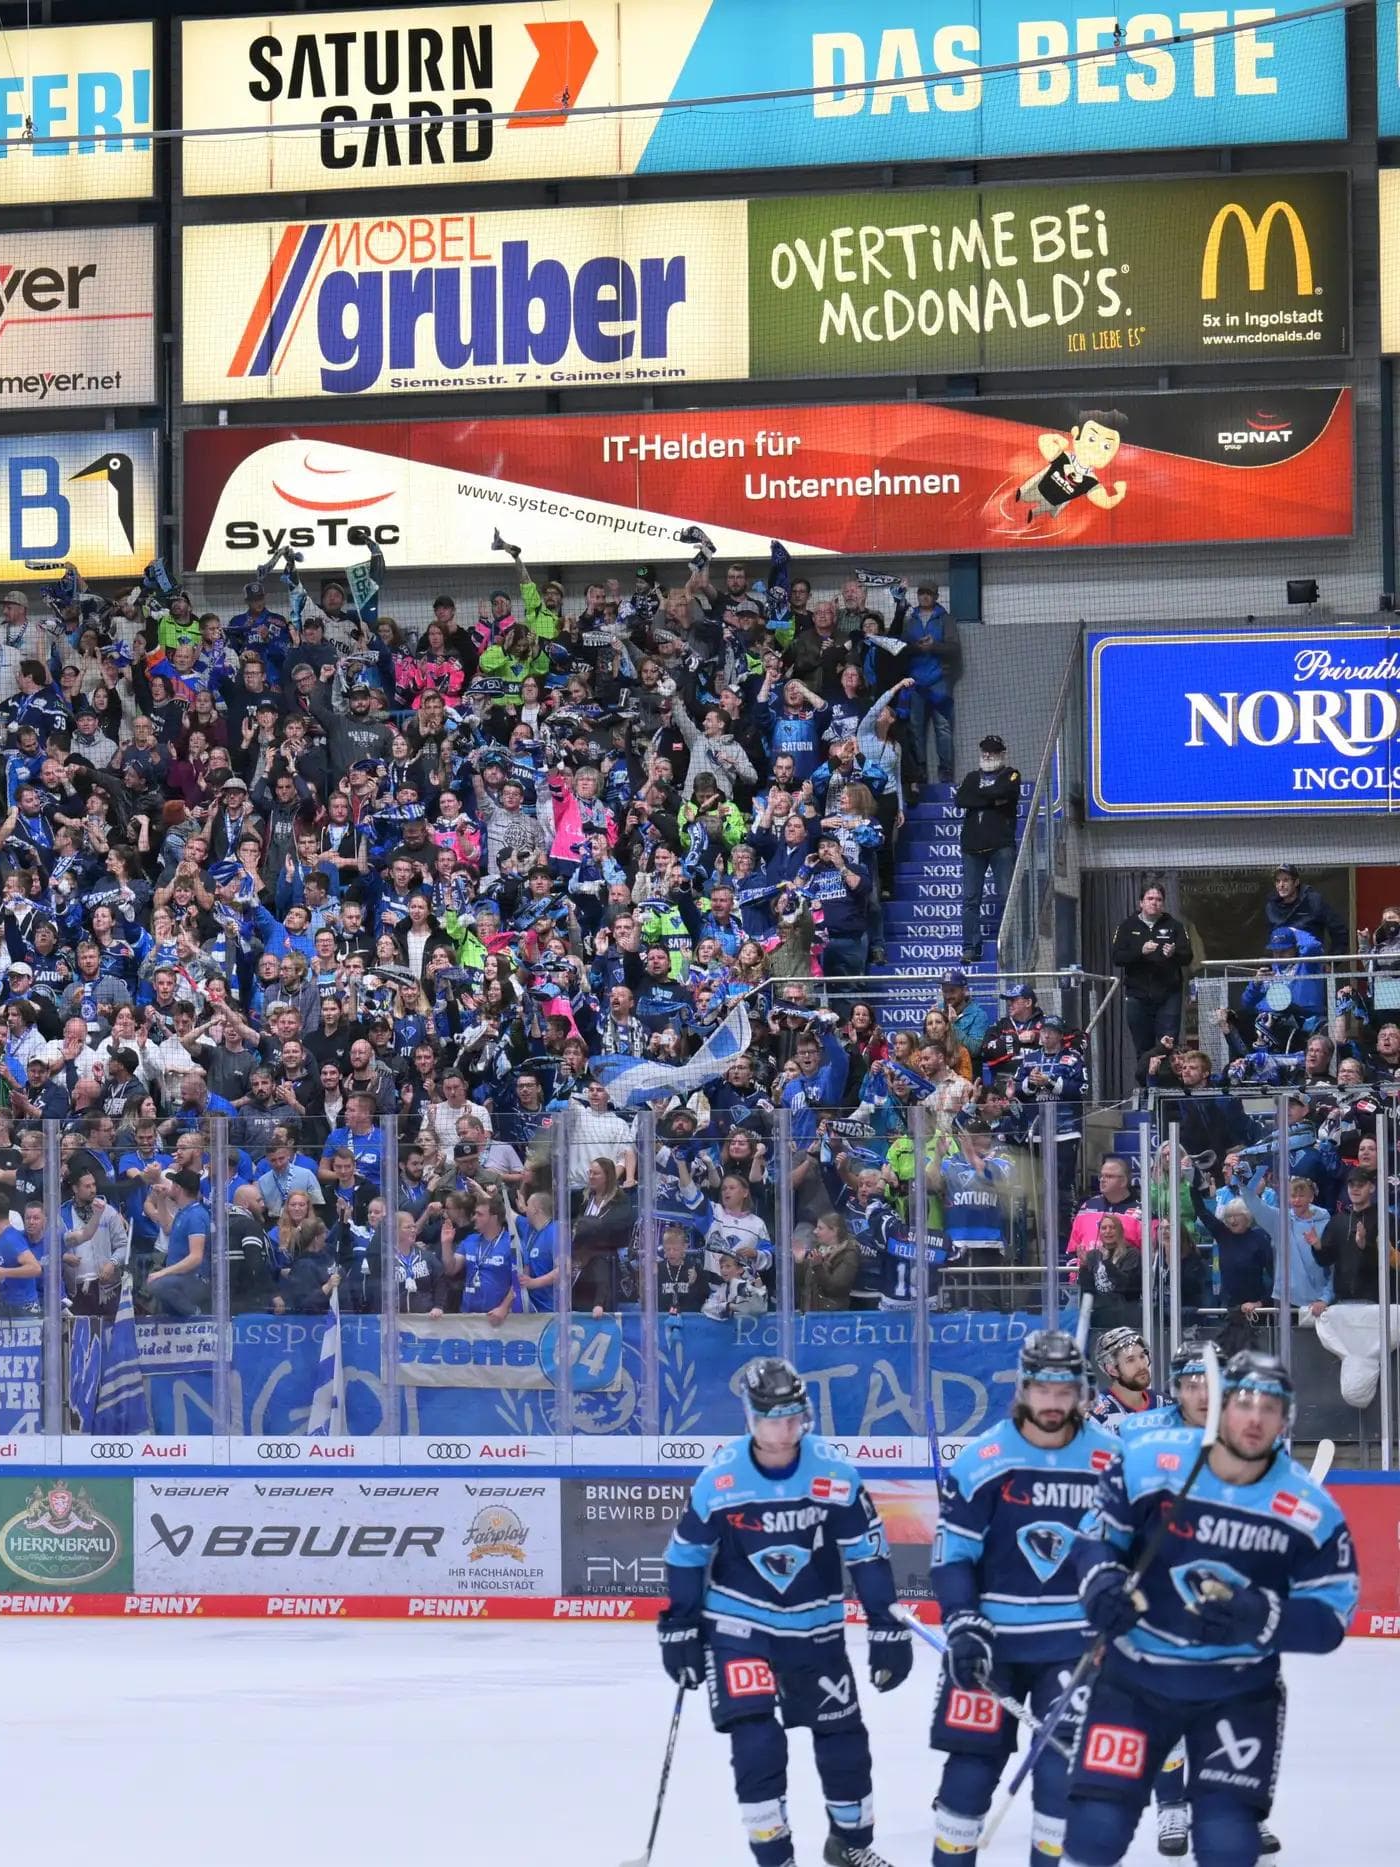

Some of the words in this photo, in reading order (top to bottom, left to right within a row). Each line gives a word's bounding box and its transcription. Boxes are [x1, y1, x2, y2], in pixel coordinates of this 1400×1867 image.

[249, 25, 492, 101] SATURN
[812, 25, 983, 118] DAS
[1018, 8, 1277, 108] BESTE
[320, 98, 493, 169] CARD
[328, 216, 492, 267] MÖBEL
[318, 240, 686, 394] gruber
[1203, 313, 1221, 327] 5x
[1226, 312, 1240, 327] in
[1245, 309, 1324, 328] Ingolstadt
[1068, 333, 1086, 353] ICH
[1092, 330, 1122, 350] LIEBE
[1203, 330, 1322, 345] www.mcdonalds.de
[390, 375, 509, 389] Siemensstr.
[515, 372, 527, 383] 7
[550, 366, 686, 382] Gaimersheim
[603, 434, 746, 462] IT-Helden
[755, 432, 801, 458] für
[1218, 430, 1293, 444] DONAT
[745, 472, 961, 500] Unternehmen
[457, 482, 688, 542] www.systec-computer.d
[225, 518, 400, 555] SysTec
[1184, 689, 1400, 757] NORD
[781, 741, 813, 752] SATURN
[953, 1191, 998, 1207] SATURN
[908, 1232, 944, 1247] SAURN
[141, 1443, 187, 1458] Audi
[309, 1443, 355, 1458] Audi
[479, 1443, 526, 1458] Audi
[856, 1444, 904, 1459] Audi
[585, 1485, 642, 1500] BRING
[648, 1485, 684, 1500] DEN
[585, 1505, 655, 1520] BEWIRB
[762, 1506, 828, 1534] SATURN
[10, 1535, 110, 1553] HERRNBRÄU
[461, 1524, 530, 1546] Fairplay
[1196, 1514, 1290, 1555] SATURN
[448, 1568, 466, 1578] IHR
[468, 1567, 544, 1578] FACHHÄNDLER
[458, 1581, 468, 1590] IN
[470, 1580, 534, 1590] INGOLSTADT
[733, 1665, 775, 1690] DB
[955, 1693, 996, 1728] DB
[1091, 1731, 1142, 1773] DB
